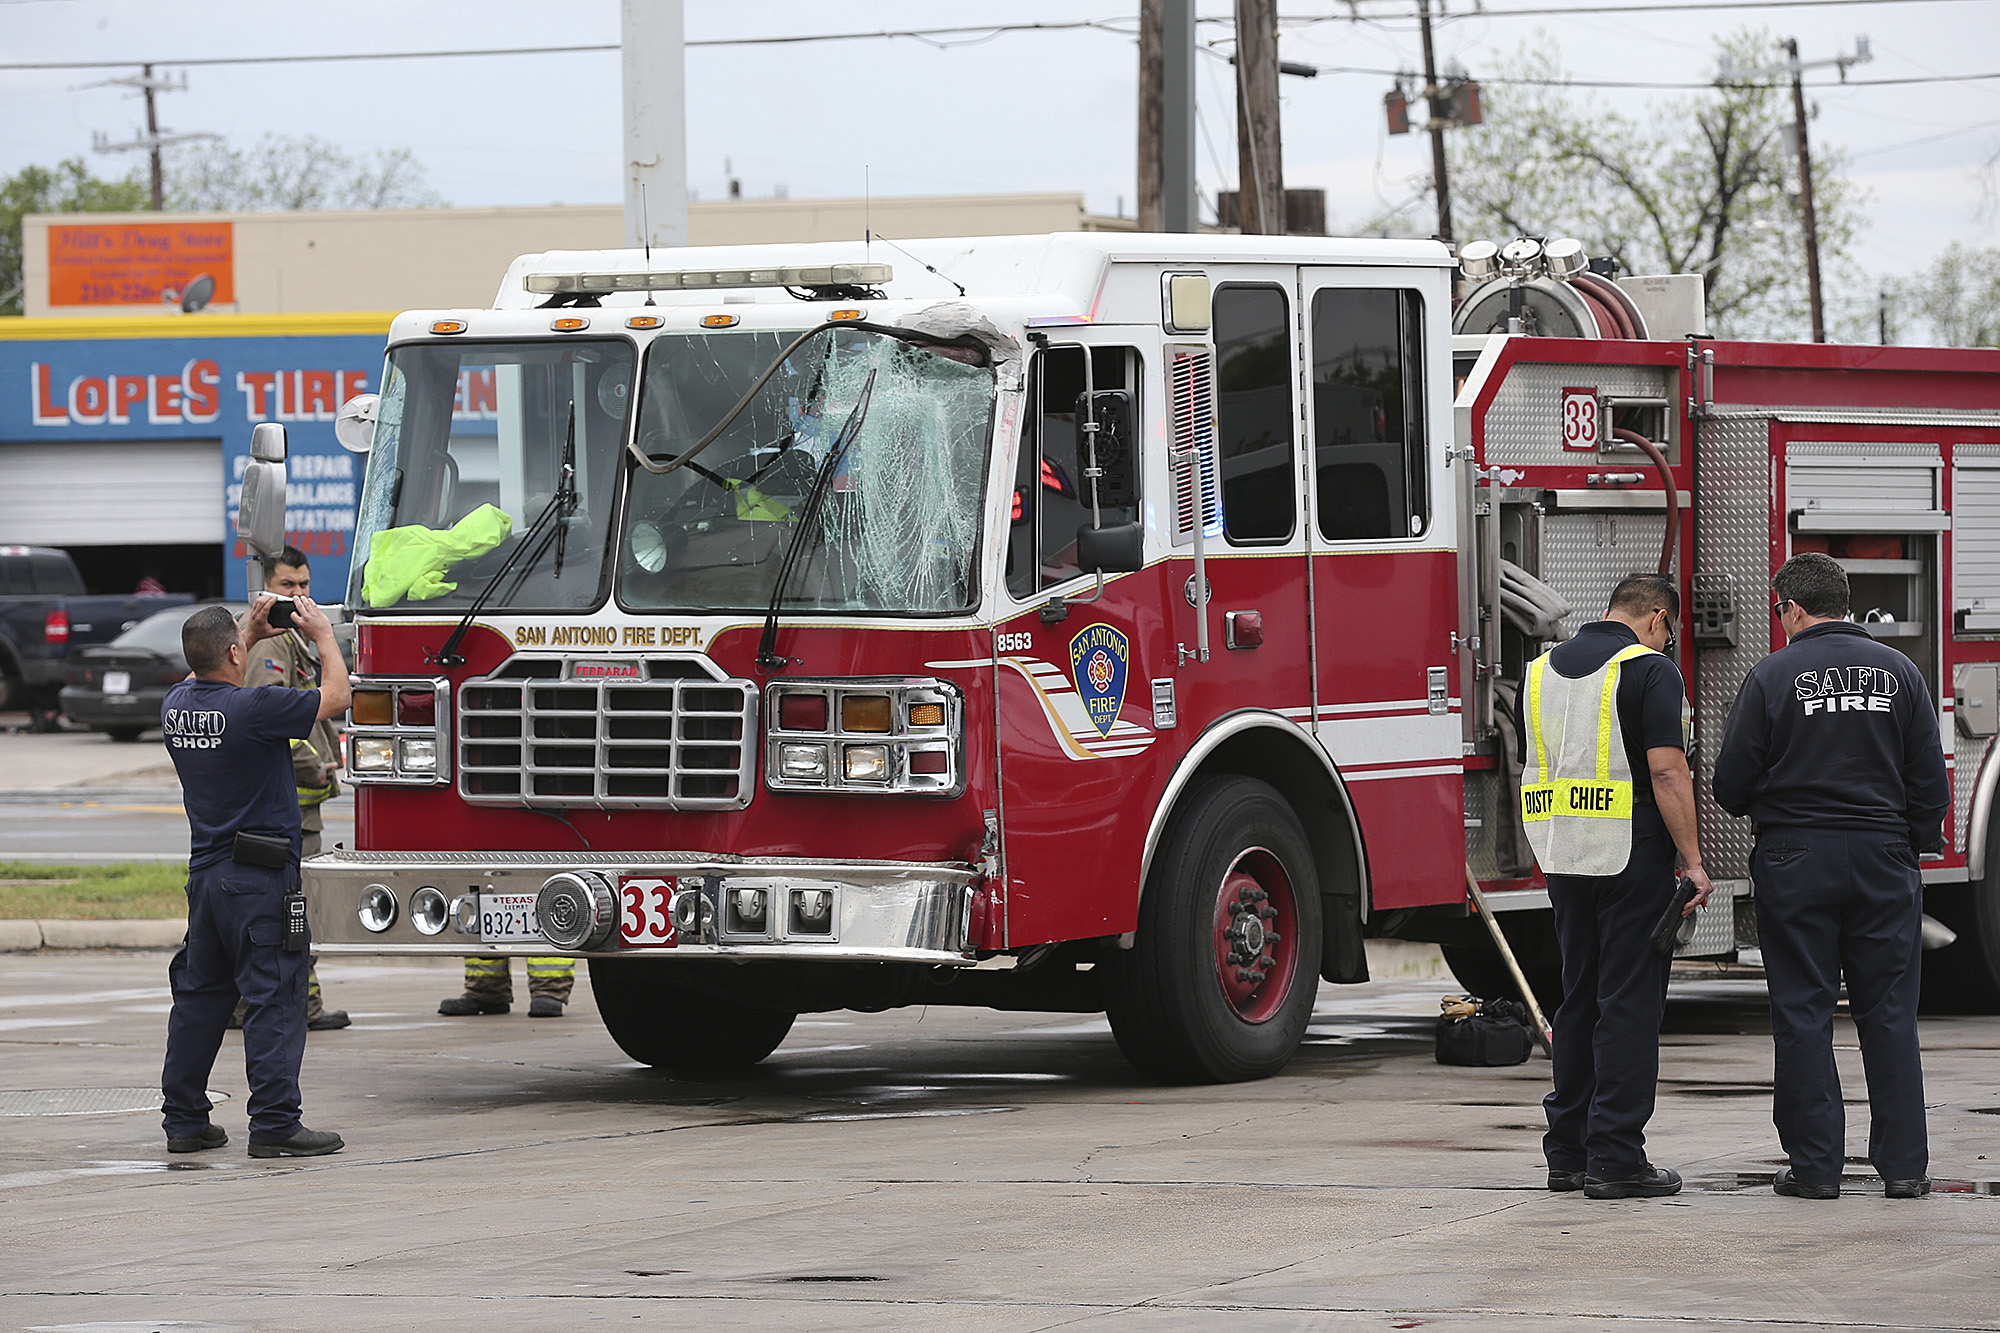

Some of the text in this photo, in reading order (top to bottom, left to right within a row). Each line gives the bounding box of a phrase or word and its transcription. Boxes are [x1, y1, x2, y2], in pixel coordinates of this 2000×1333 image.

[1566, 400, 1595, 441] 33
[290, 455, 353, 479] REPAIR
[285, 508, 355, 532] OTATION
[515, 626, 704, 646] SAN ANTONIO FIRE DEPT.
[997, 631, 1032, 651] 8563
[1073, 628, 1126, 666] SAN ANTONIO
[576, 666, 631, 676] FERRARA
[1794, 665, 1899, 700] SAFD
[1089, 696, 1117, 714] FIRE
[1804, 695, 1892, 716] FIRE
[164, 708, 226, 736] SAFD
[1094, 714, 1112, 724] DEPT.
[172, 736, 222, 749] SHOP
[1570, 786, 1614, 811] CHIEF
[500, 896, 534, 904] TEXAS
[621, 885, 676, 938] 33
